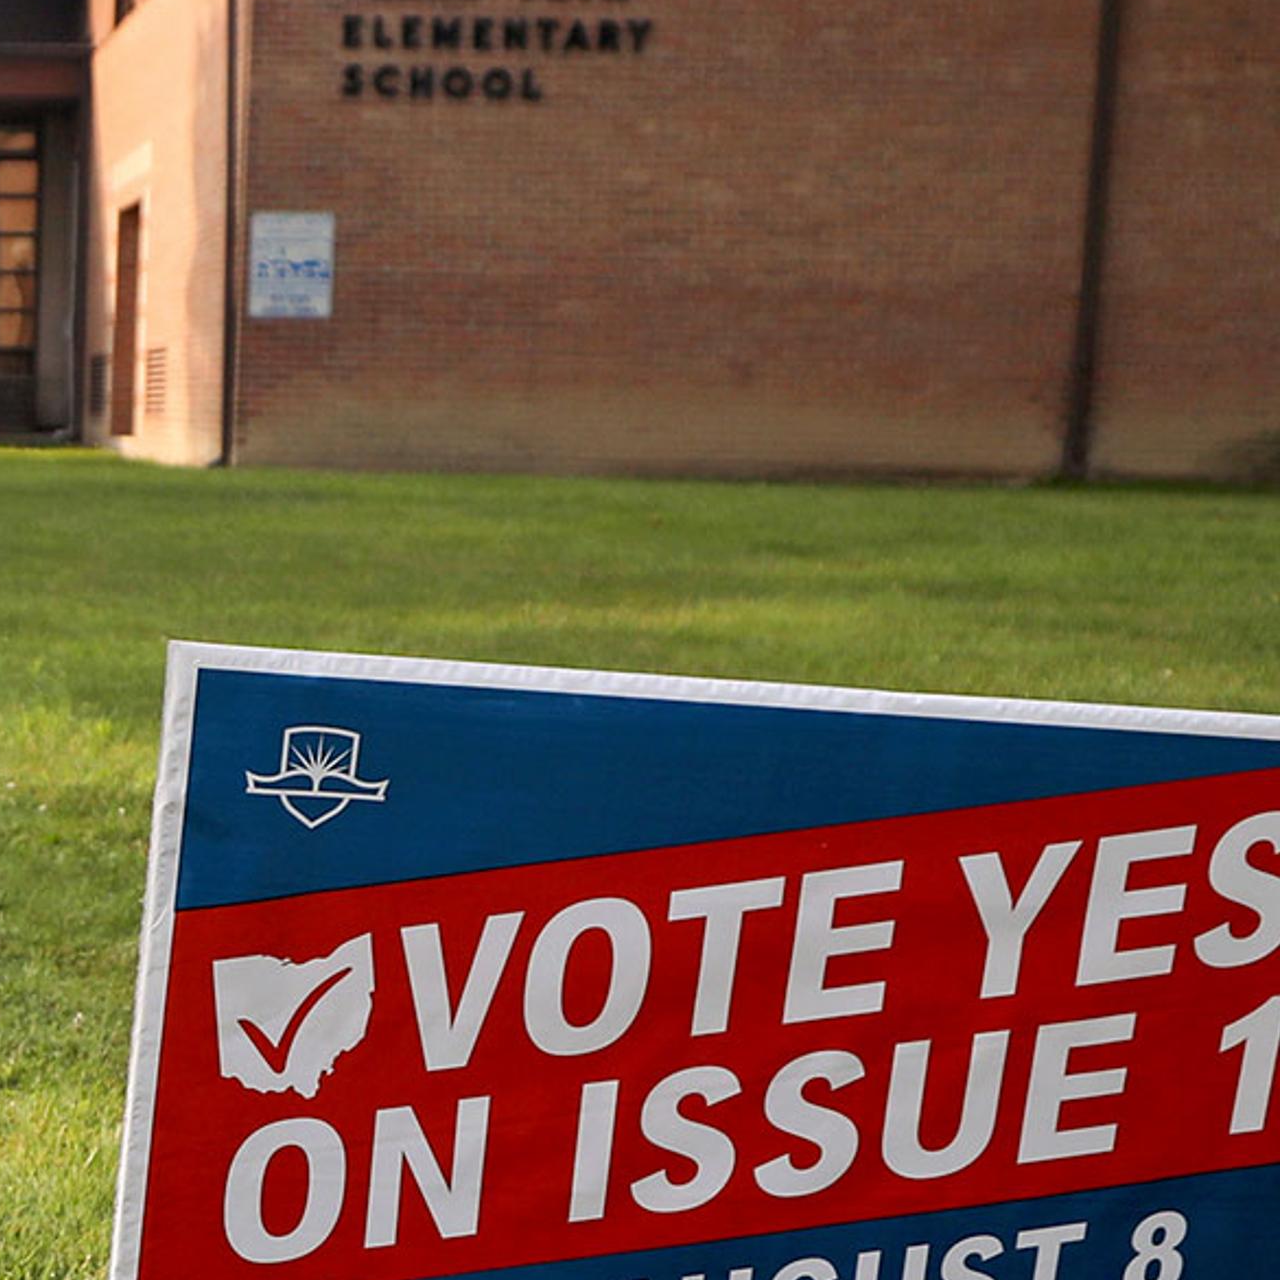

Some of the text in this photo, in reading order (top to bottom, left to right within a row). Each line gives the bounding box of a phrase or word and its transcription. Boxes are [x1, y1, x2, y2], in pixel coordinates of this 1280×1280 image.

[343, 15, 652, 52] ELEMENTARY
[343, 64, 544, 100] SCHOOL
[400, 810, 1280, 1072] VOTE YES
[223, 995, 1280, 1264] ON ISSUE 1
